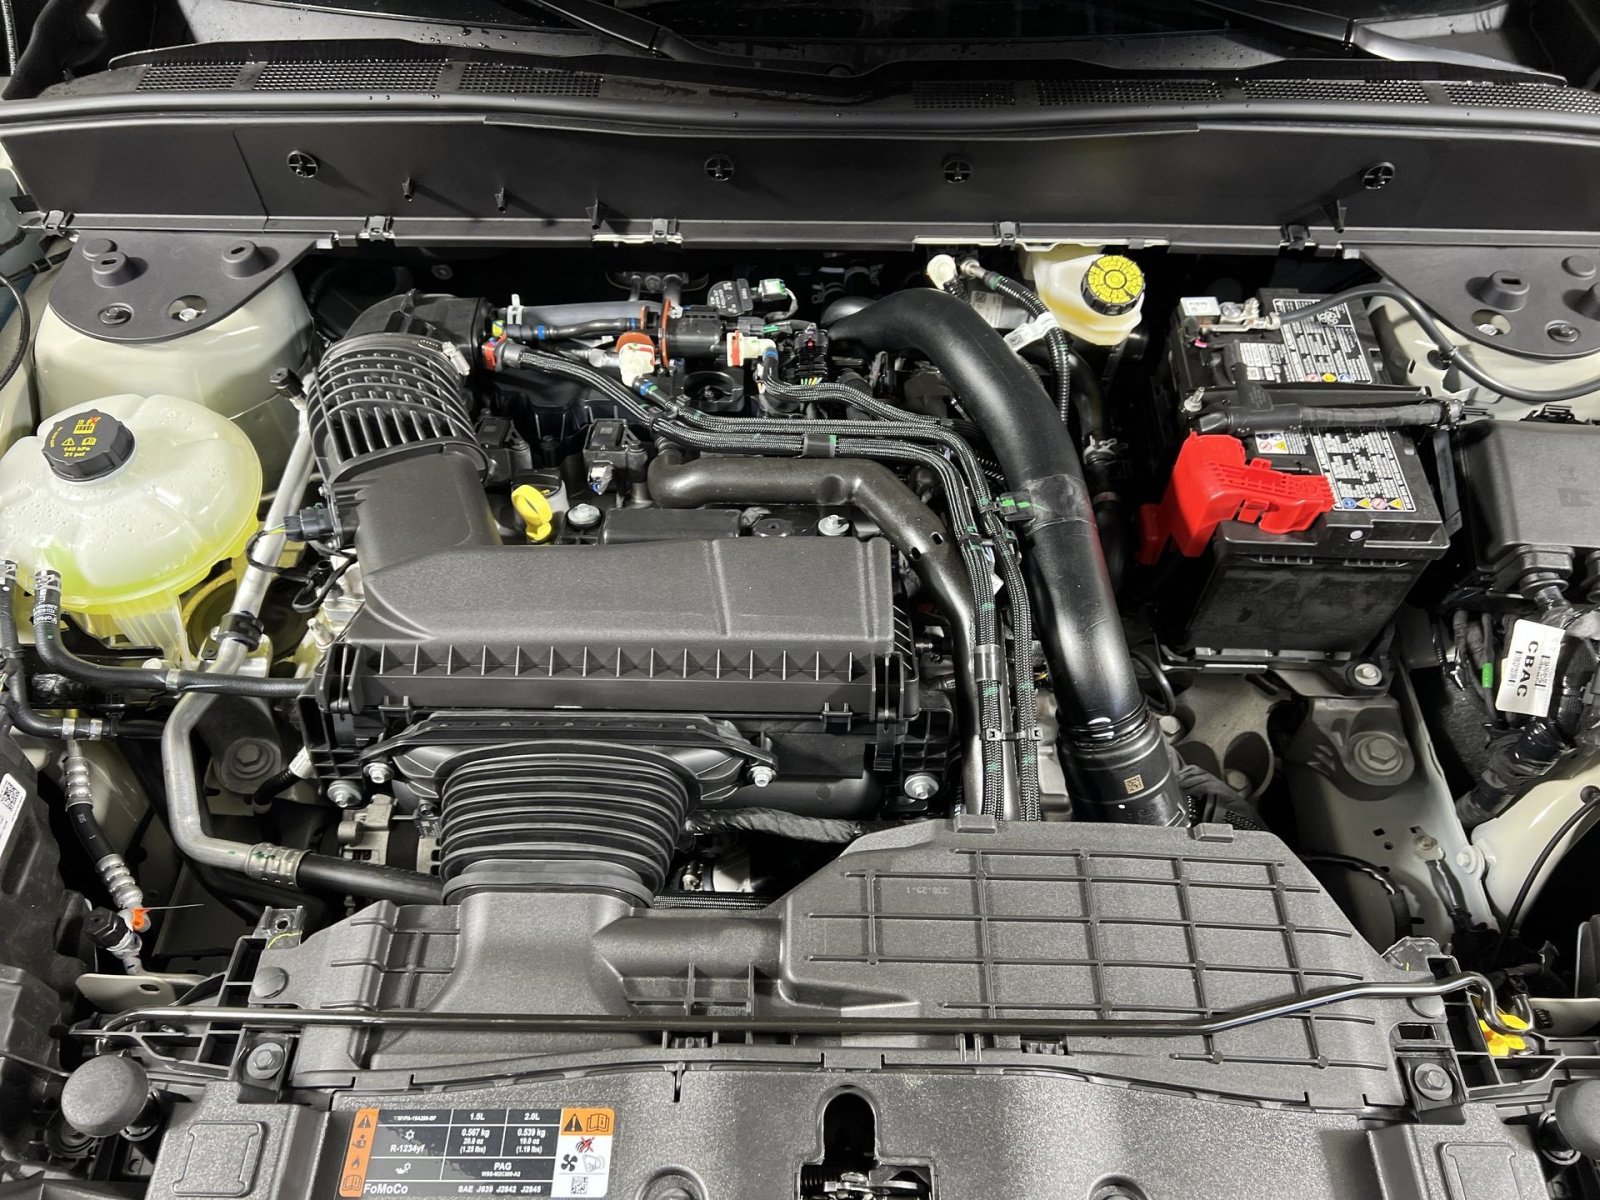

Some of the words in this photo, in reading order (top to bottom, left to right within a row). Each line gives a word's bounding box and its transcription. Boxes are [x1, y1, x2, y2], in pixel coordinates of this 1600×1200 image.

[1516, 640, 1539, 698] CBAC
[469, 1112, 486, 1121] 1.5L
[523, 1112, 541, 1121] 2.0L
[480, 1128, 491, 1138] kg
[517, 1127, 537, 1137] 0.539
[536, 1128, 546, 1138] kg
[389, 1144, 426, 1154] R-1234yf
[493, 1162, 512, 1171] PAG
[363, 1182, 409, 1195] FoMoCo
[458, 1185, 474, 1194] SAE
[476, 1185, 494, 1194] J639
